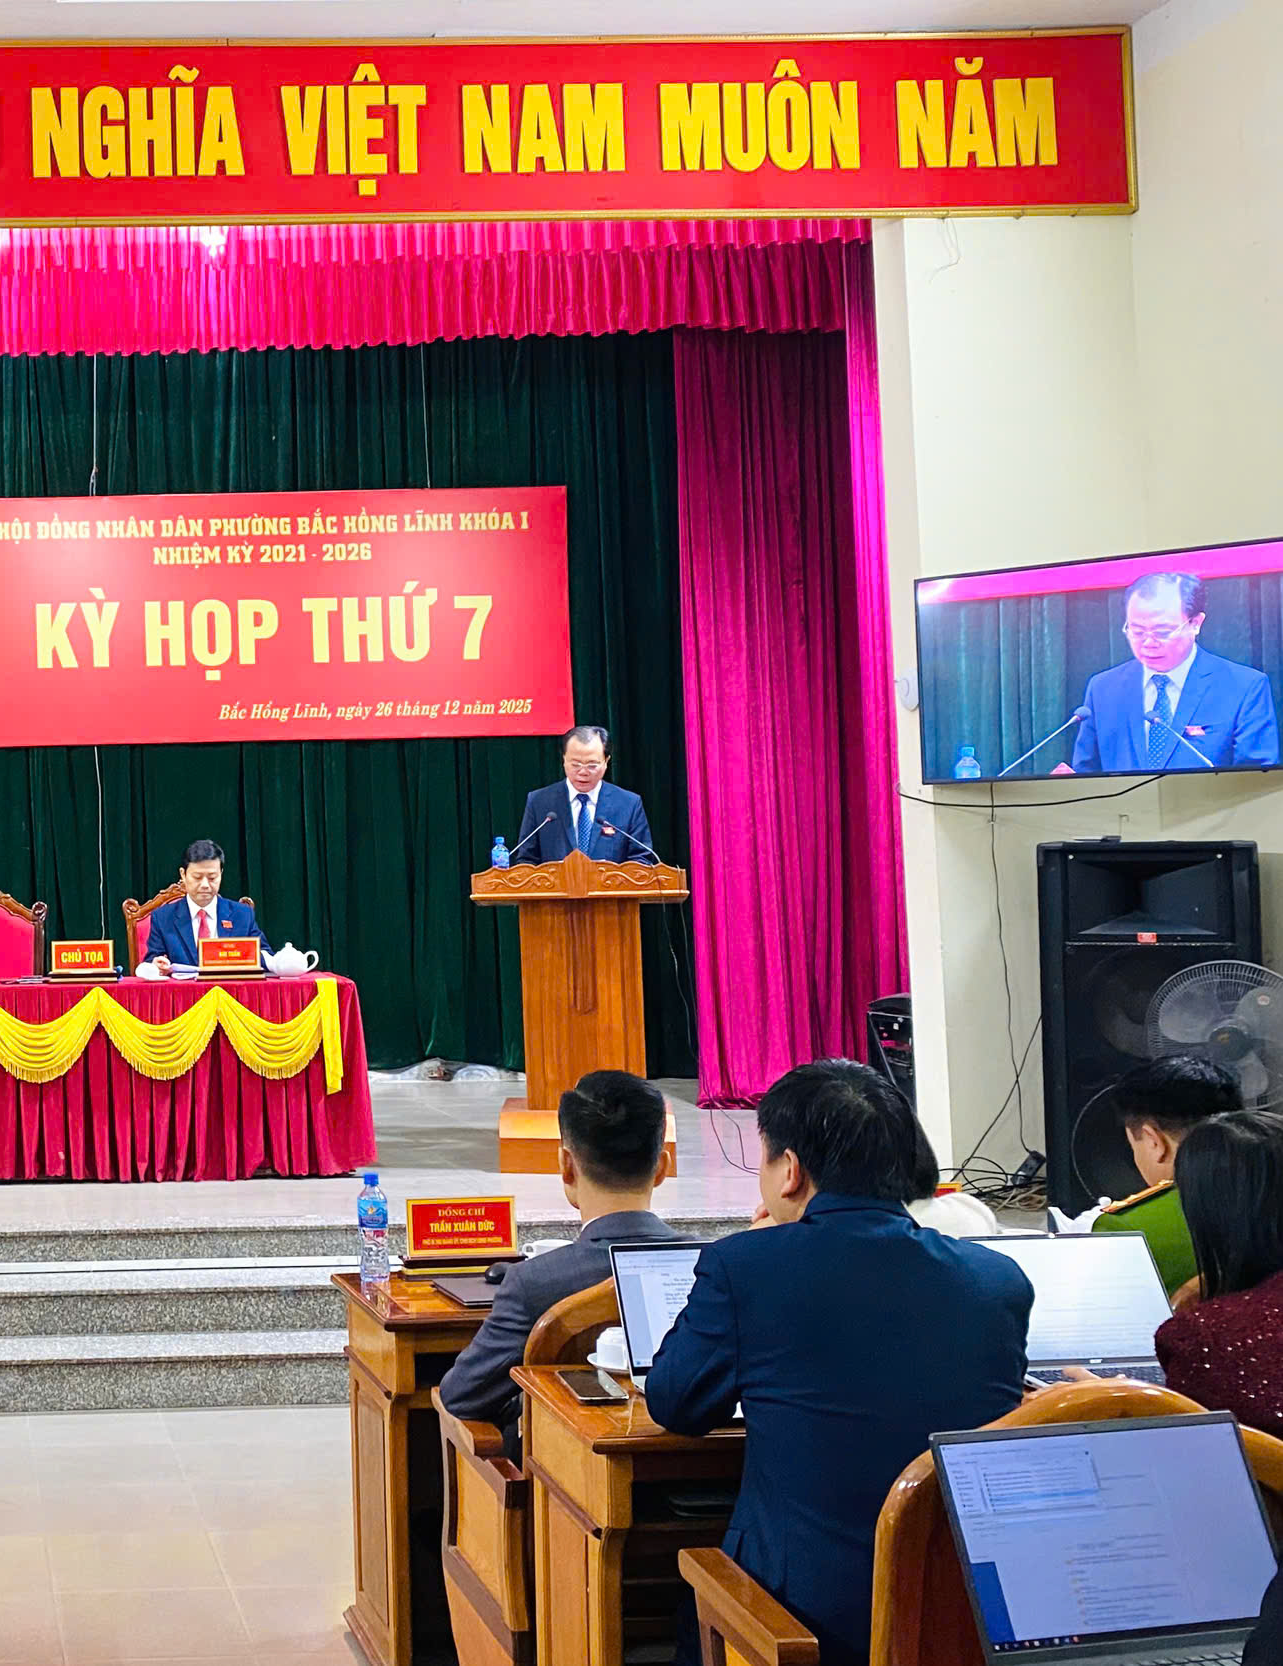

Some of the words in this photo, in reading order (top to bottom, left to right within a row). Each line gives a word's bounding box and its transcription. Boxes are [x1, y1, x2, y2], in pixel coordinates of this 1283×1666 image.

[31, 64, 246, 179] NGHĨA
[280, 63, 427, 196] VIỆT
[461, 82, 626, 174] NAM
[659, 58, 861, 173] MUÔN
[896, 56, 1058, 170] NĂM
[37, 512, 90, 540] ĐỒNG
[96, 515, 155, 539] NHÂN
[160, 515, 203, 538] DÂN
[209, 512, 291, 537] PHƯỜNG
[297, 508, 338, 535] BẮC
[343, 506, 398, 533] HỒNG
[404, 510, 453, 532] LĨNH
[459, 508, 515, 531] KHÓA
[153, 542, 221, 569] NHIỆM
[226, 540, 254, 563] KỲ
[260, 544, 306, 563] 2021
[322, 543, 372, 561] 2026
[35, 587, 120, 669] KỲ
[144, 599, 279, 681] HỌP
[302, 580, 438, 663] THỨ
[453, 595, 493, 660] 7
[218, 702, 247, 720] Bắc
[250, 702, 289, 721] Hồng
[292, 703, 332, 720] Lĩnh,
[336, 702, 372, 720] ngày
[375, 702, 392, 716] 26
[396, 700, 440, 719] tháng
[443, 700, 460, 715] 12
[463, 700, 495, 715] năm
[498, 698, 533, 714] 2025
[61, 948, 82, 963] CHỦ
[85, 951, 104, 965] TỌA
[438, 1206, 466, 1217] ĐỒNG
[467, 1206, 486, 1216] CHÍ
[453, 1220, 476, 1232] XUÂN
